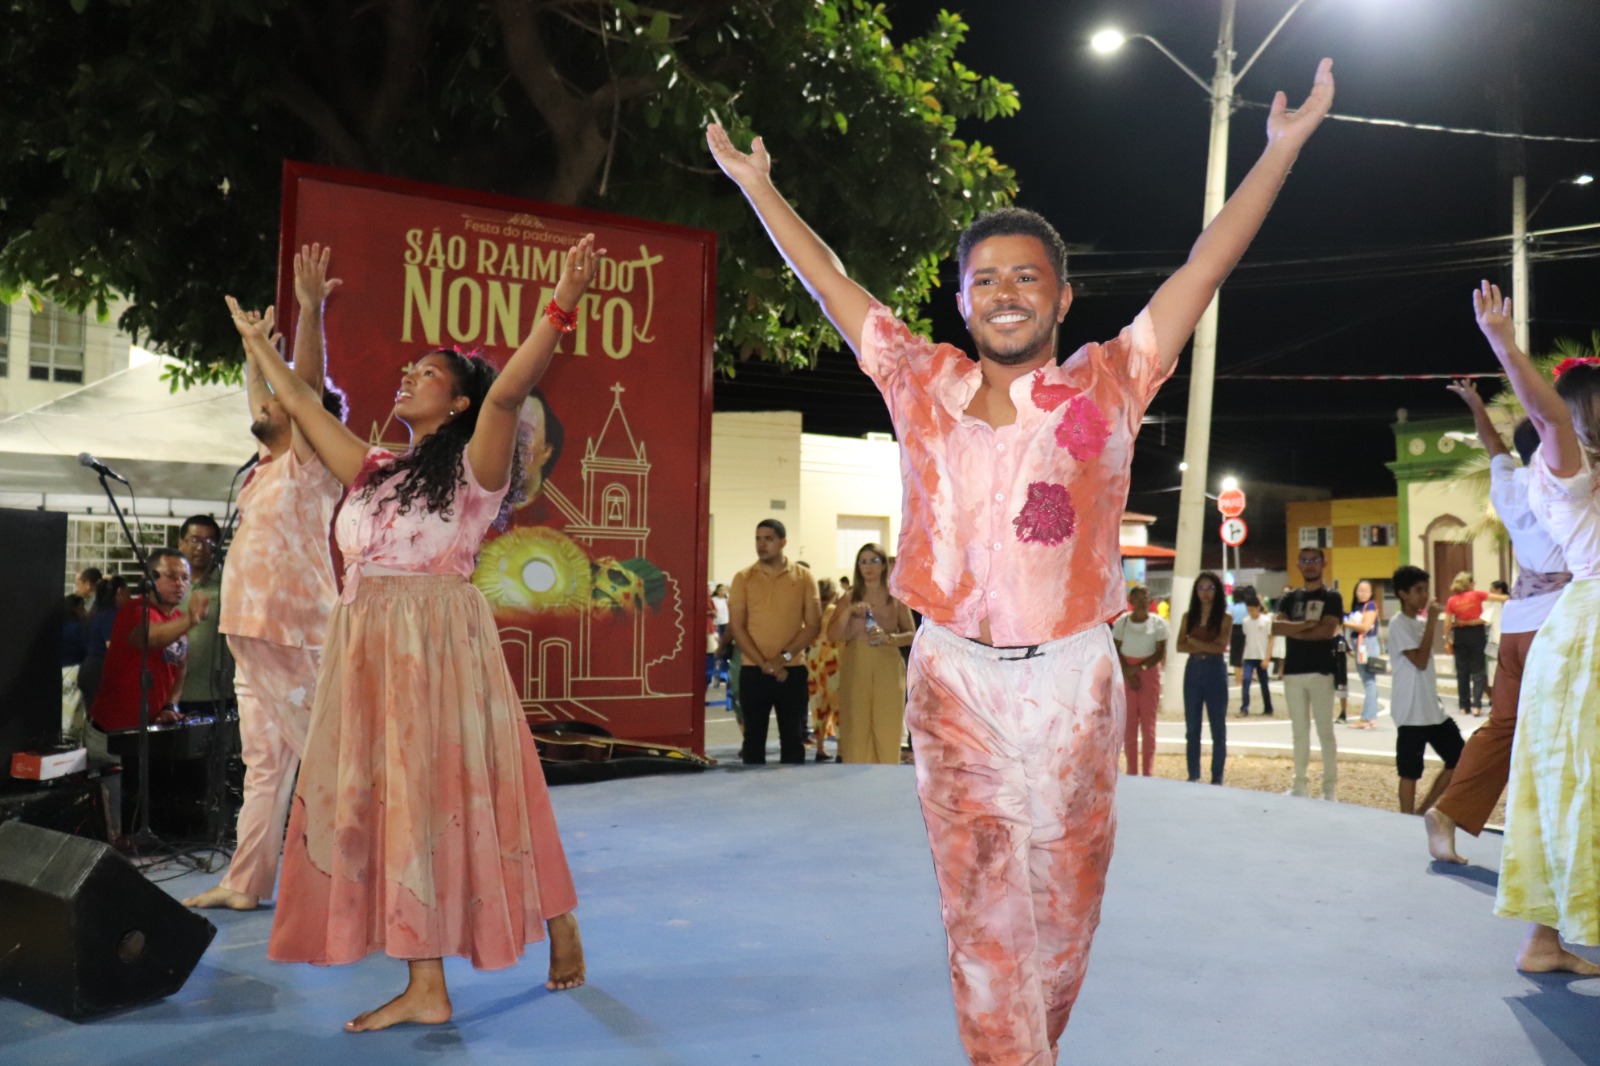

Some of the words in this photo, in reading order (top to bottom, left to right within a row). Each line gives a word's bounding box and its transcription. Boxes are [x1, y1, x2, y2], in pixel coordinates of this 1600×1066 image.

[464, 219, 500, 235] Festa
[502, 225, 520, 238] do
[477, 238, 635, 293] RAIMDO
